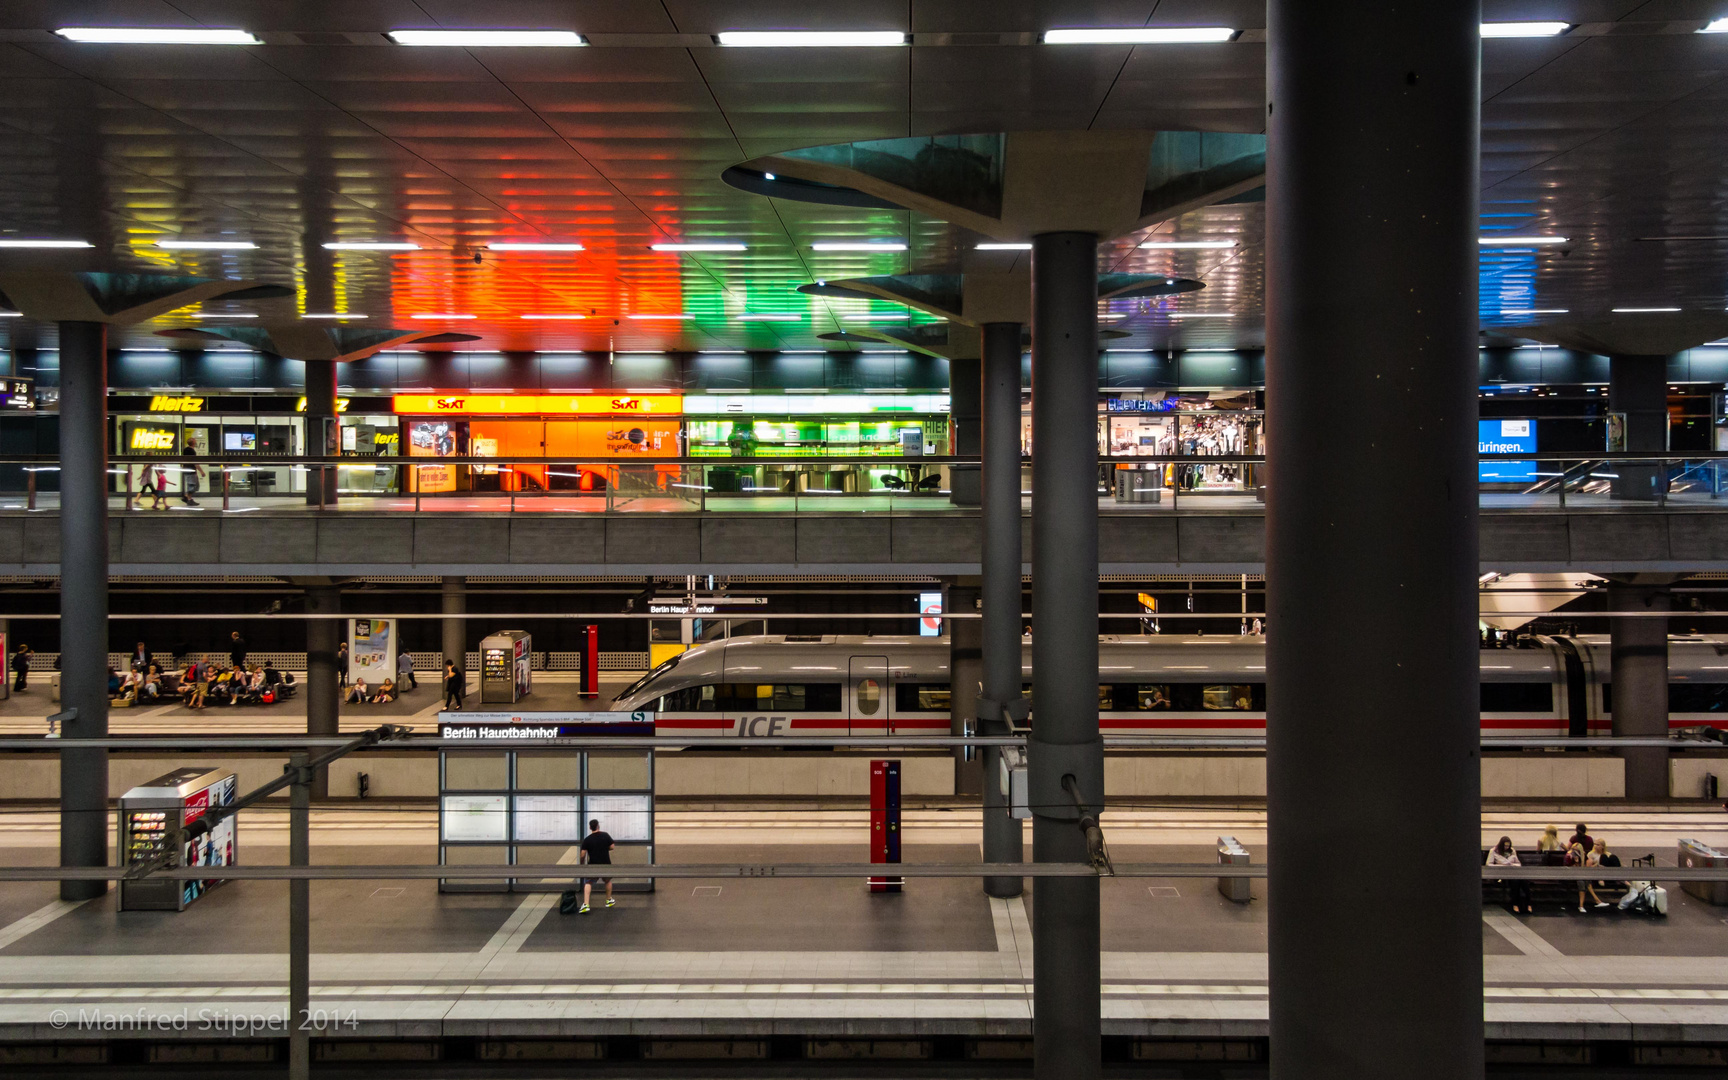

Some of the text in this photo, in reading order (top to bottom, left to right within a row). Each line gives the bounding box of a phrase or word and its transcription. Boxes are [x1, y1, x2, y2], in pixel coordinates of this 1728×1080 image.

[14, 382, 28, 394] 7-8
[150, 395, 204, 412] Hertz
[132, 427, 175, 449] Hertz
[632, 711, 644, 722] S
[443, 727, 559, 739] Berlin Hauptbahnhof
[738, 716, 787, 738] ICE
